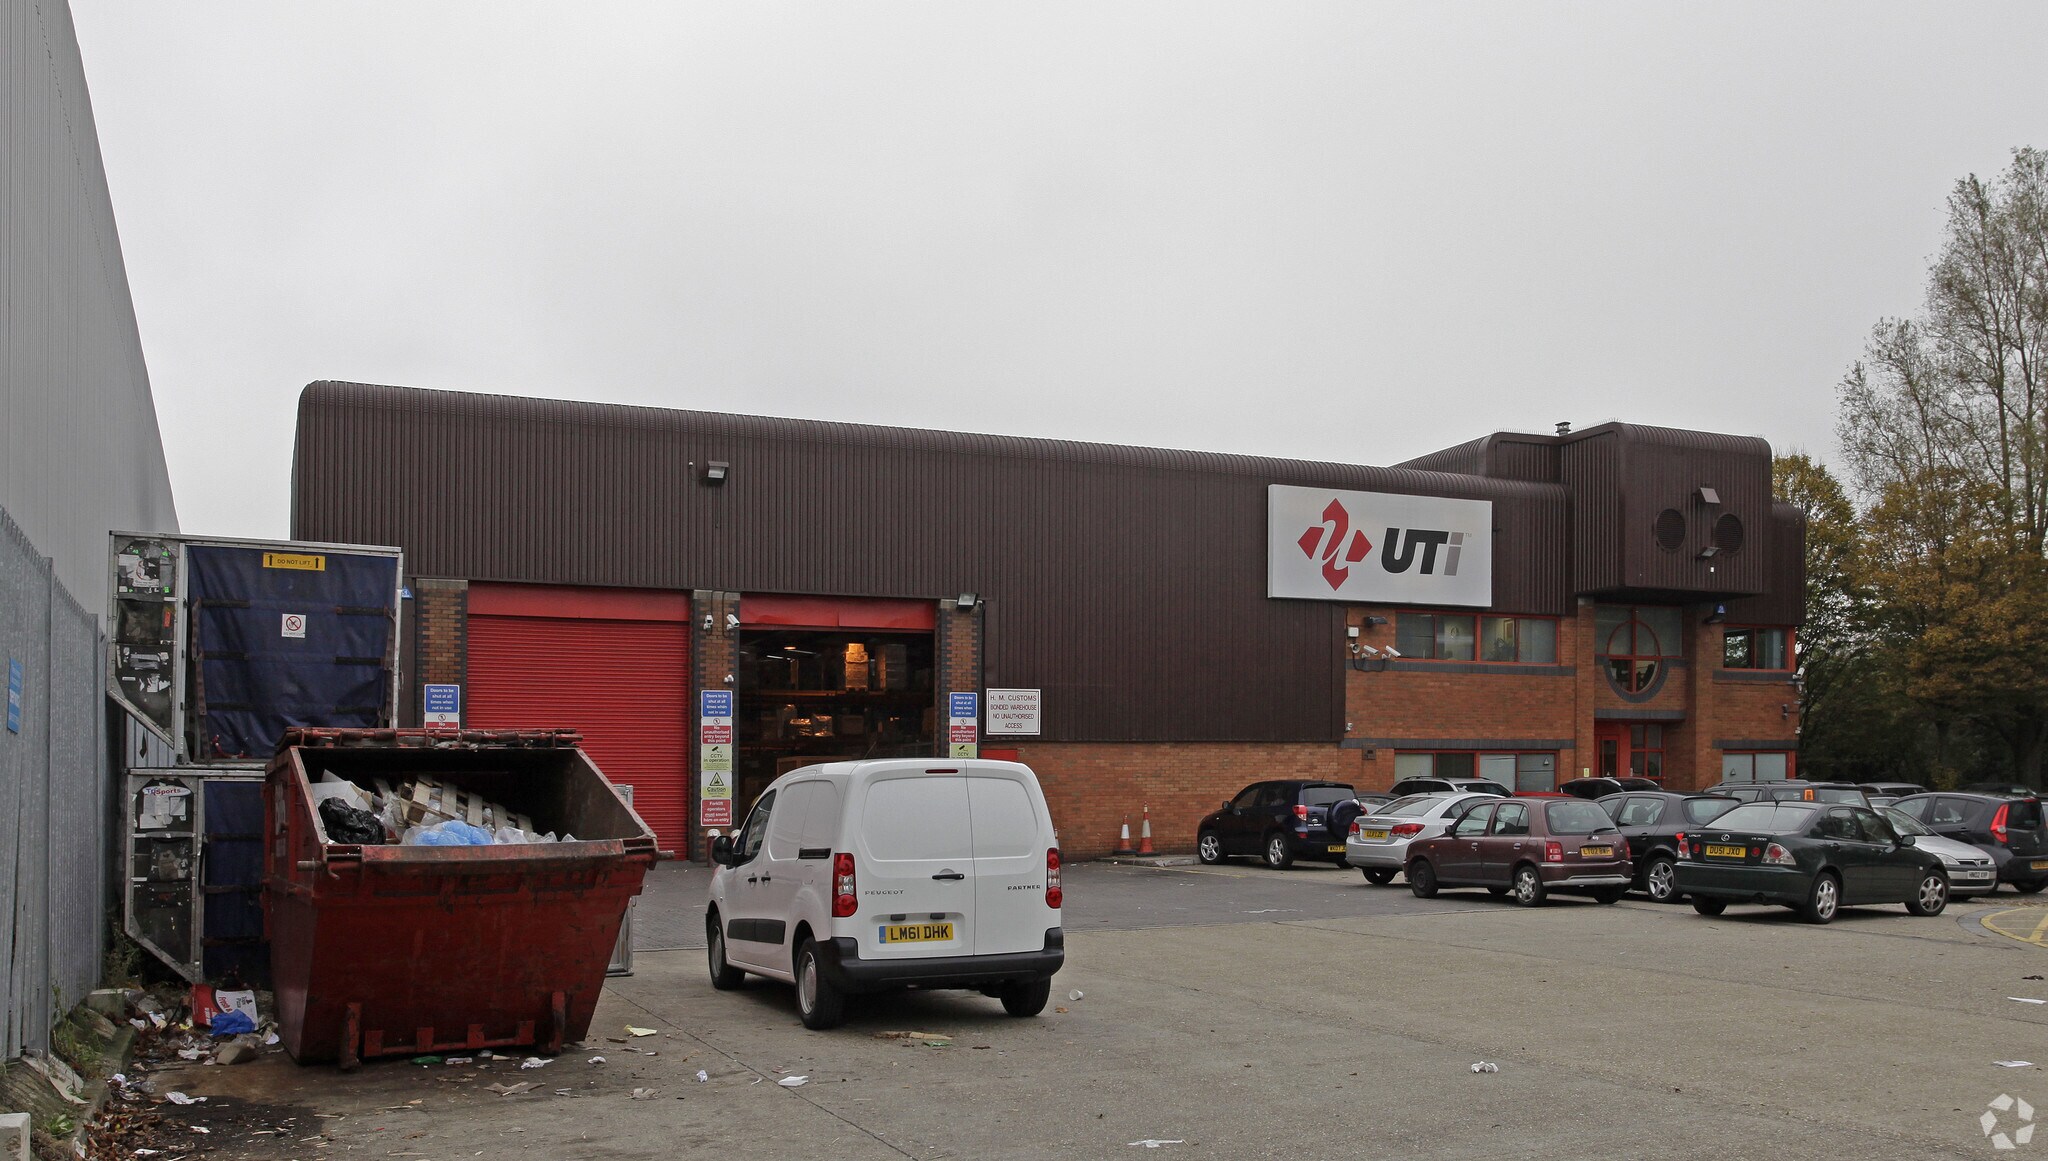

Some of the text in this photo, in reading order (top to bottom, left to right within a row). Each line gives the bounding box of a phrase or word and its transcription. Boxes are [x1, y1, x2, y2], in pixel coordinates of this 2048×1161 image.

[1381, 527, 1464, 576] UTi
[890, 926, 949, 941] LM61 DHK
